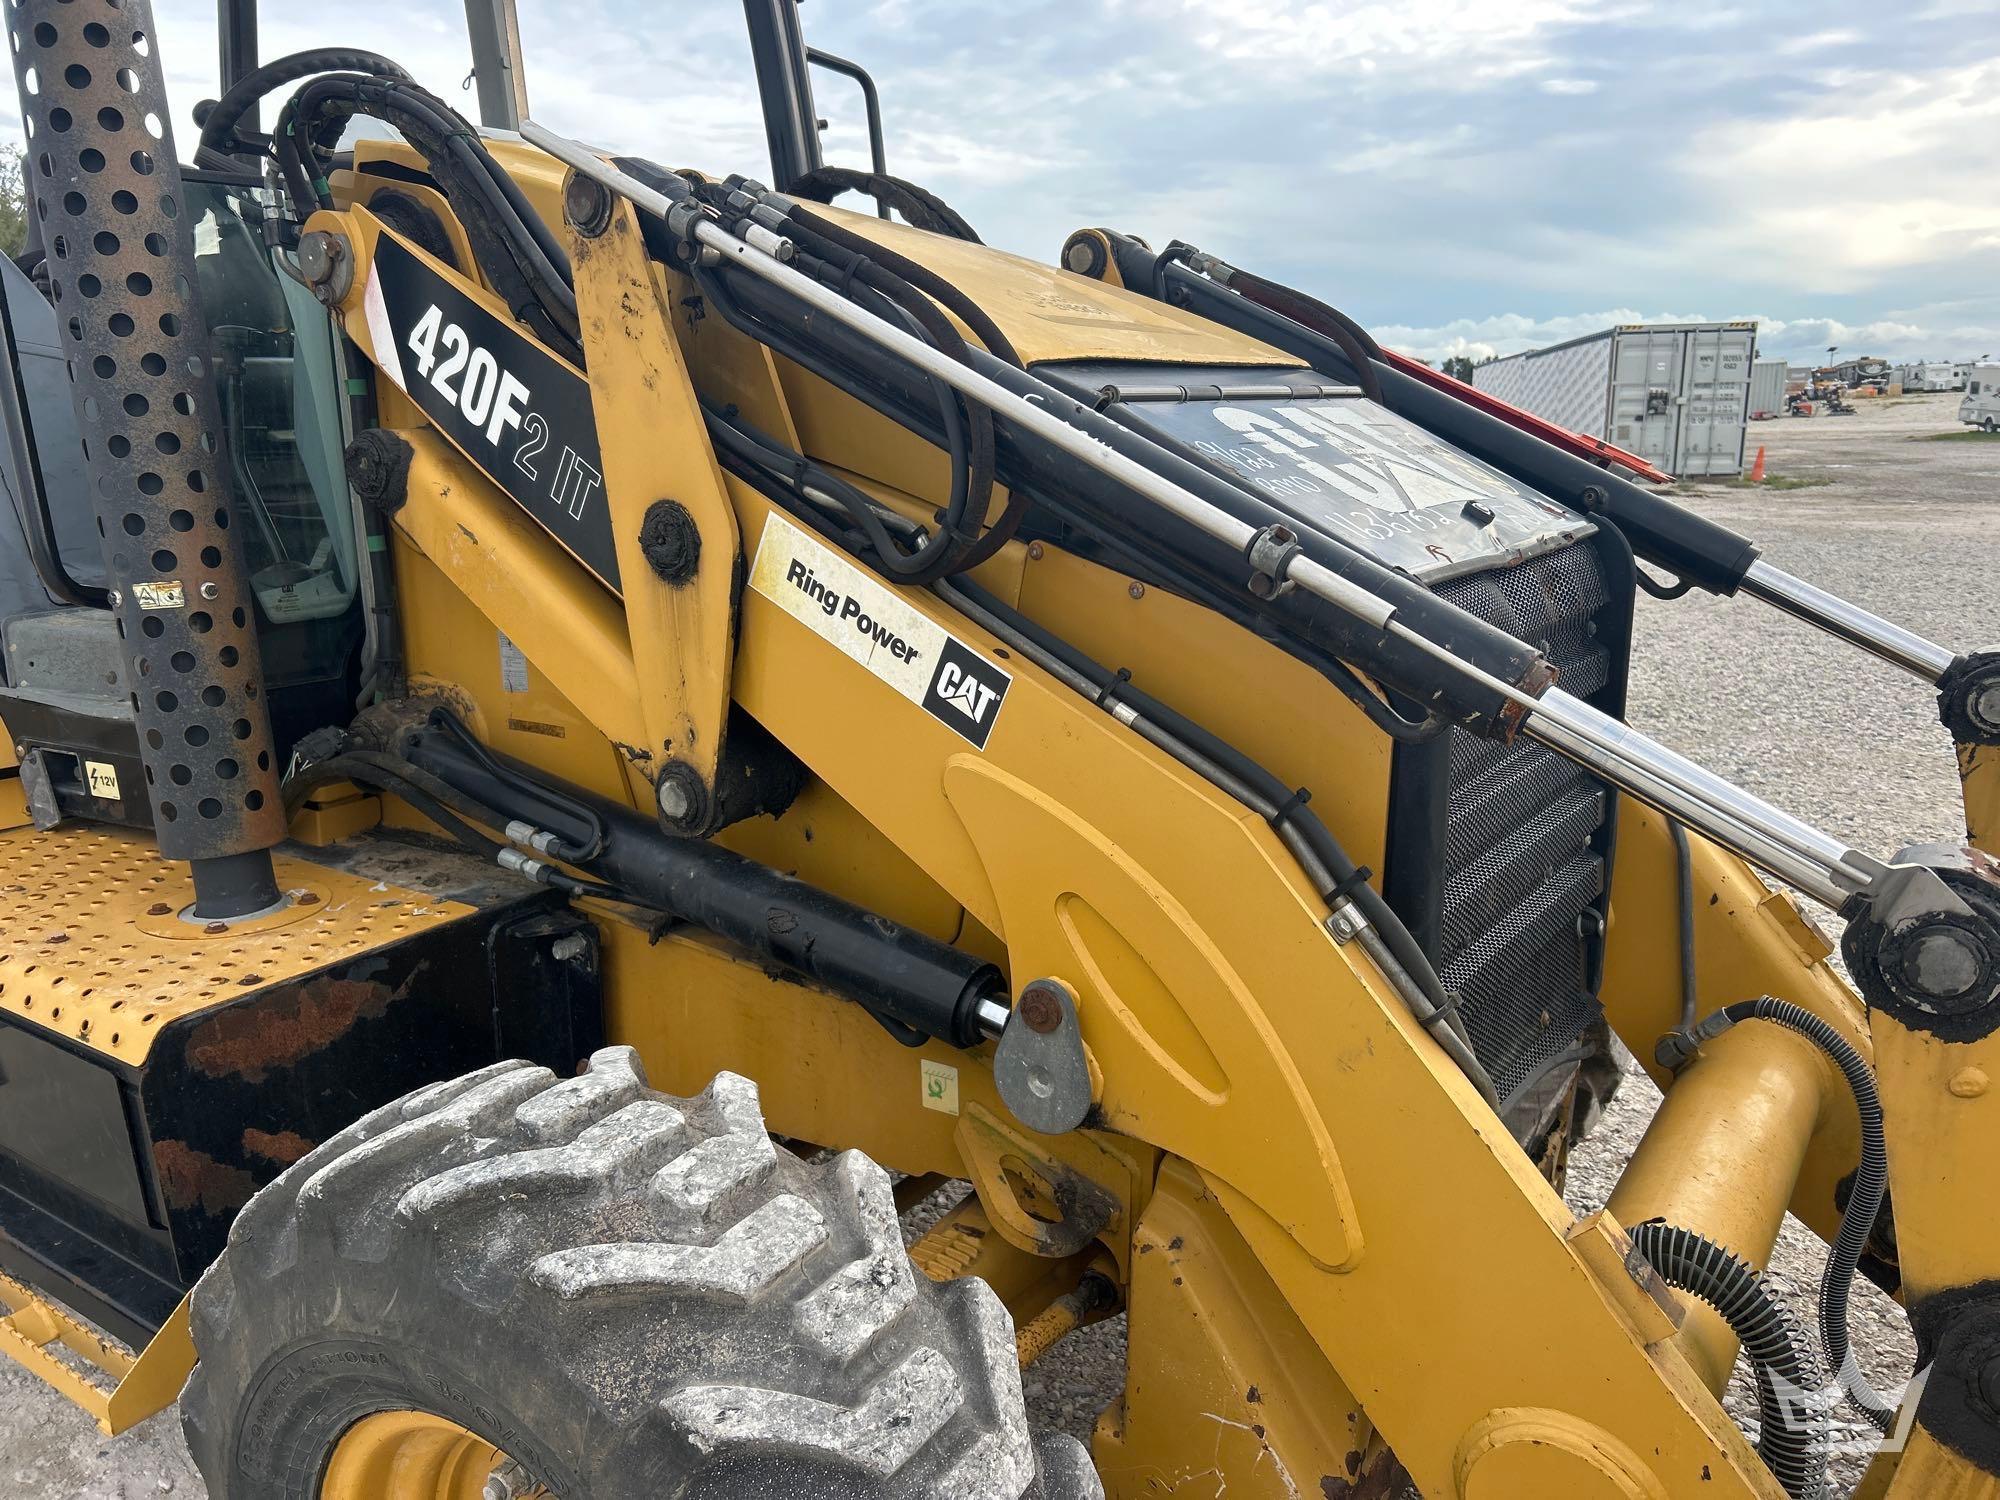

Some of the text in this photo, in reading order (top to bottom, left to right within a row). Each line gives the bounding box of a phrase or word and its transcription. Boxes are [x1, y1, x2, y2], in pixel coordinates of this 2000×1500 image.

[407, 303, 603, 521] 420F2 IT
[786, 558, 919, 665] Ring Power
[936, 661, 998, 724] CAT
[99, 775, 115, 787] 12V
